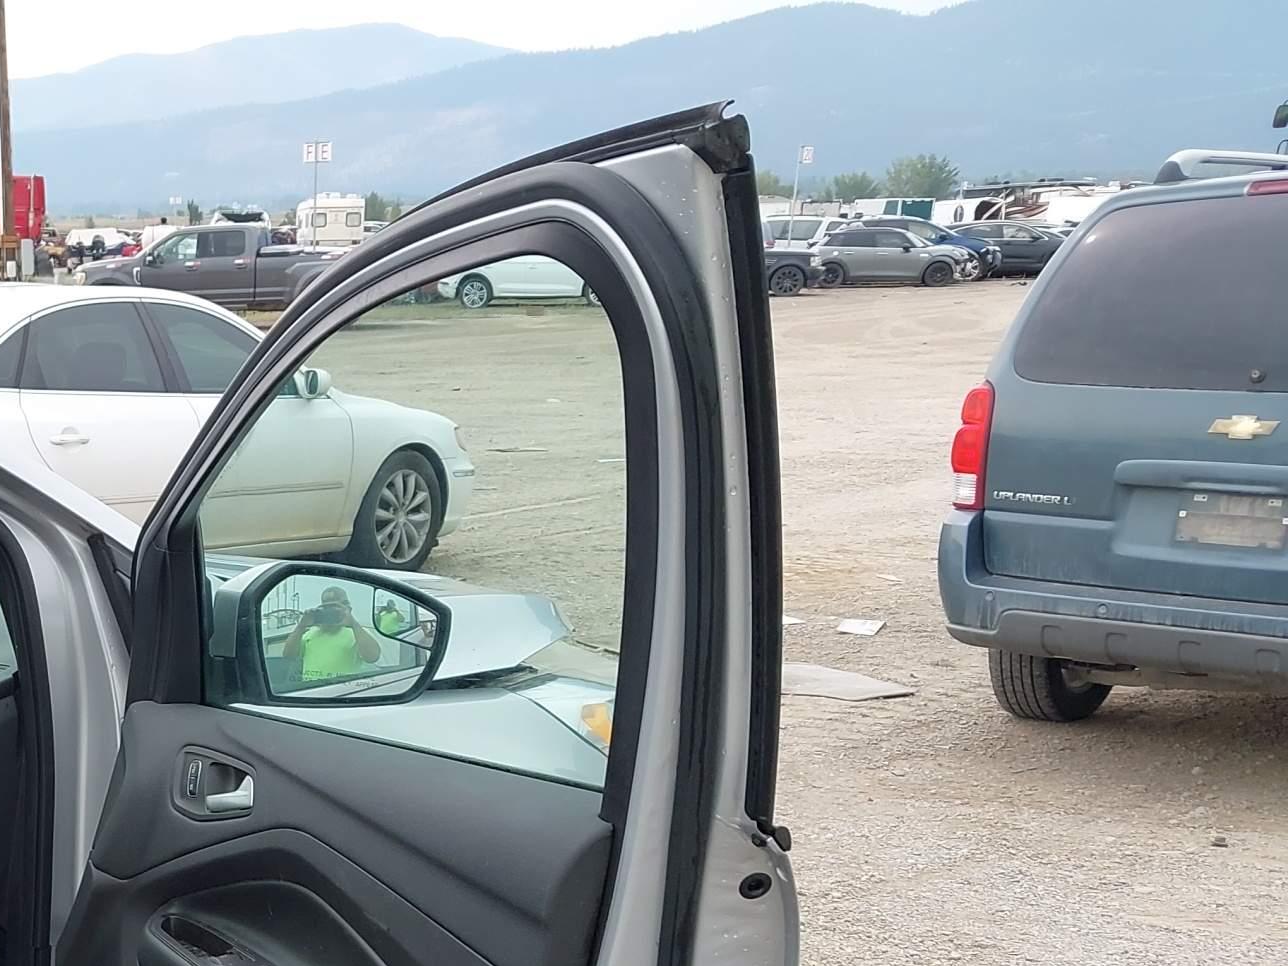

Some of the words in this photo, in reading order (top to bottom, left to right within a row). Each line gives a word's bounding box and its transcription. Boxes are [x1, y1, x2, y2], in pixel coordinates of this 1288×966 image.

[306, 144, 313, 161] F
[321, 143, 329, 160] E
[993, 490, 1061, 505] UPLANDER
